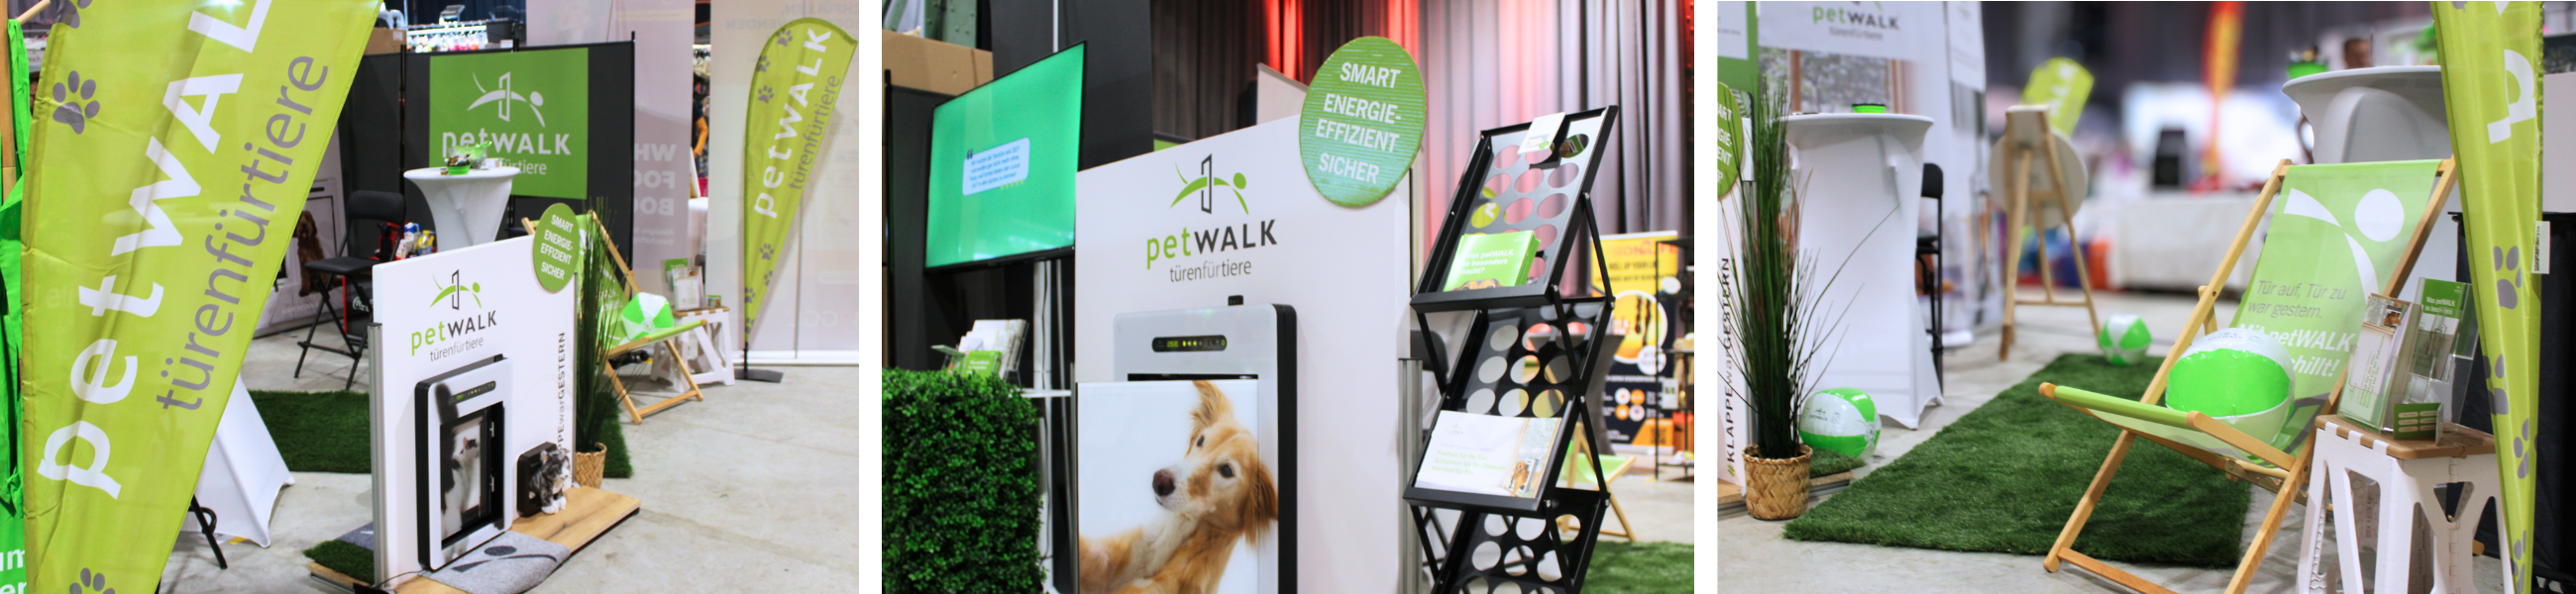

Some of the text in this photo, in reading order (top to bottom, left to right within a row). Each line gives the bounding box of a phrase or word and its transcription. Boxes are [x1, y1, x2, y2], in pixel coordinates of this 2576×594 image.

[1812, 5, 1900, 32] petWALK
[1339, 61, 1400, 89] SMART
[1323, 93, 1402, 124] ENERGIE-
[753, 28, 832, 219] petWALK
[788, 75, 841, 190] türenfürtiere
[1316, 118, 1400, 152] EFFIZIENT
[442, 128, 572, 158] petWALK
[1318, 152, 1380, 184] SICHER
[156, 56, 328, 412] türenfürtiere
[551, 214, 574, 234] SMART
[544, 229, 574, 251] ENERGIE-
[1146, 219, 1278, 270] petWALK
[540, 243, 573, 265] EFFIZIENT
[1480, 249, 1514, 259] petWALK
[541, 261, 566, 280] SICHER
[1169, 259, 1252, 283] türenfürtiere
[2256, 280, 2347, 300] Tür auf, Tür zu
[2248, 301, 2322, 319] war gestern.
[411, 310, 497, 356] petWALK
[430, 338, 483, 361] türenfürtiere
